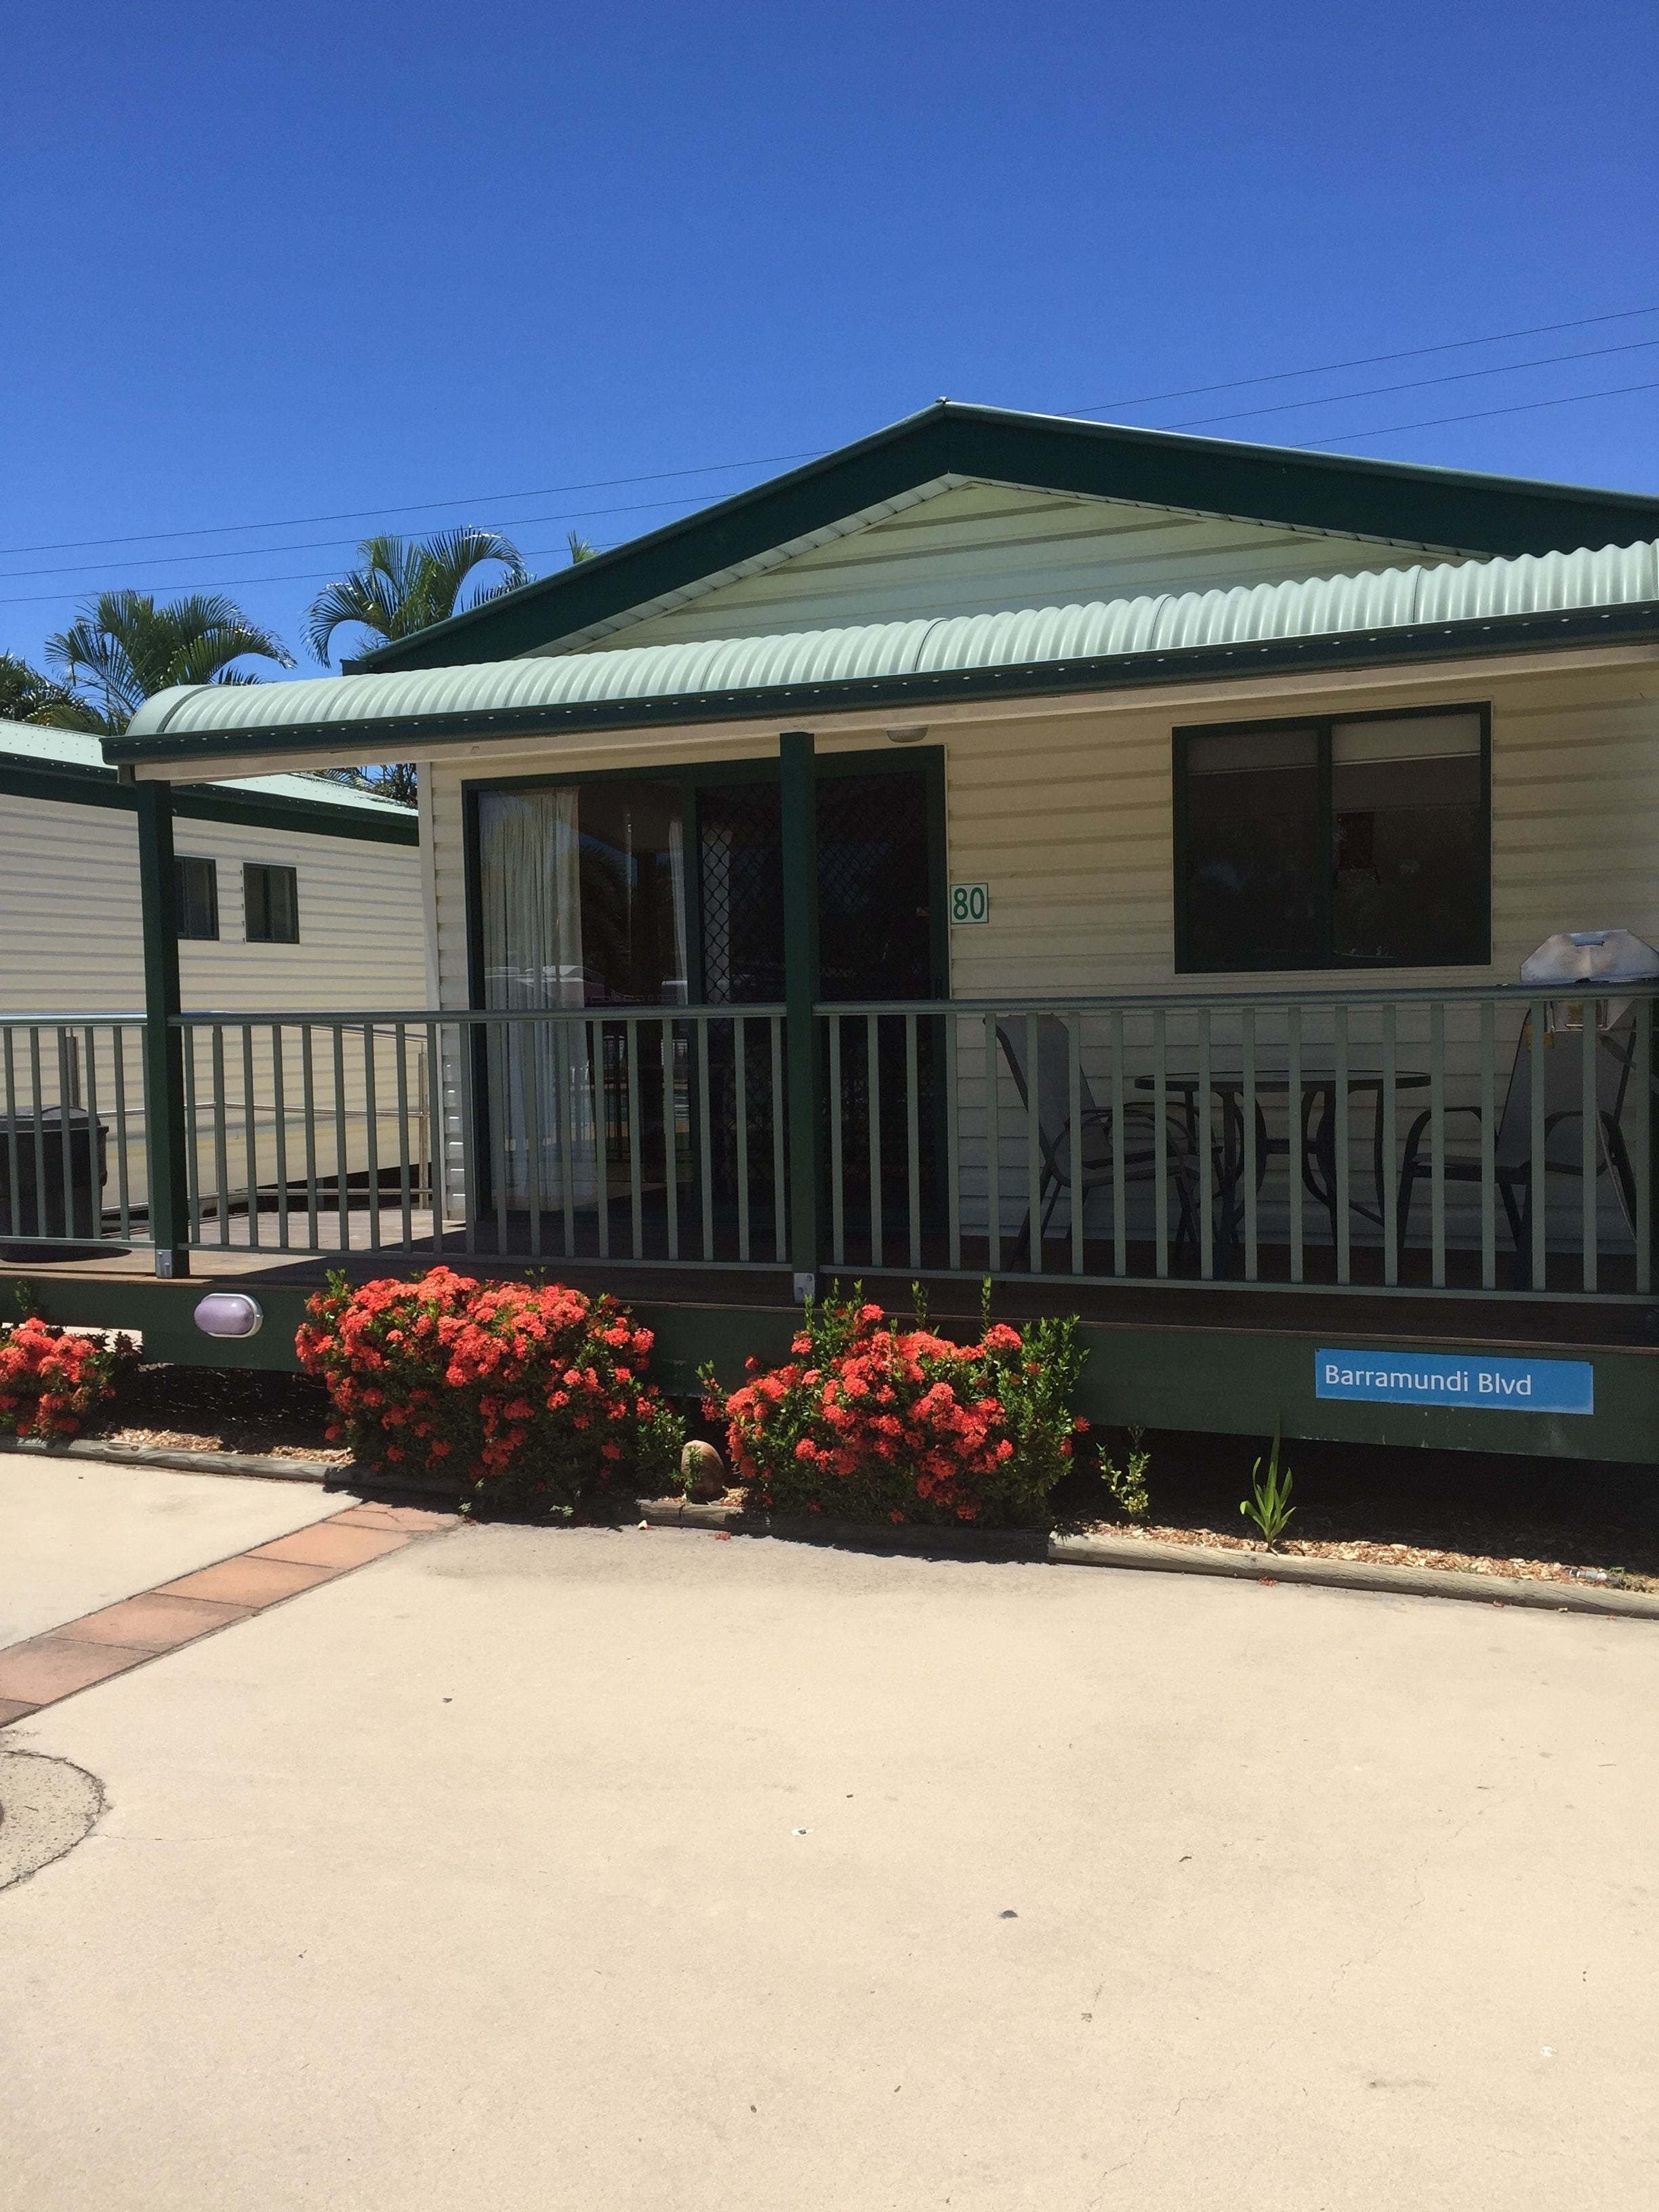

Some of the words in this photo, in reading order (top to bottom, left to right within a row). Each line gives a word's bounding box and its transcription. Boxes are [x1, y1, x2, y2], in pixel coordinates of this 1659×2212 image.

[954, 887, 985, 920] 80
[1325, 1364, 1469, 1393] Barramundi
[1478, 1372, 1532, 1396] Blvd
